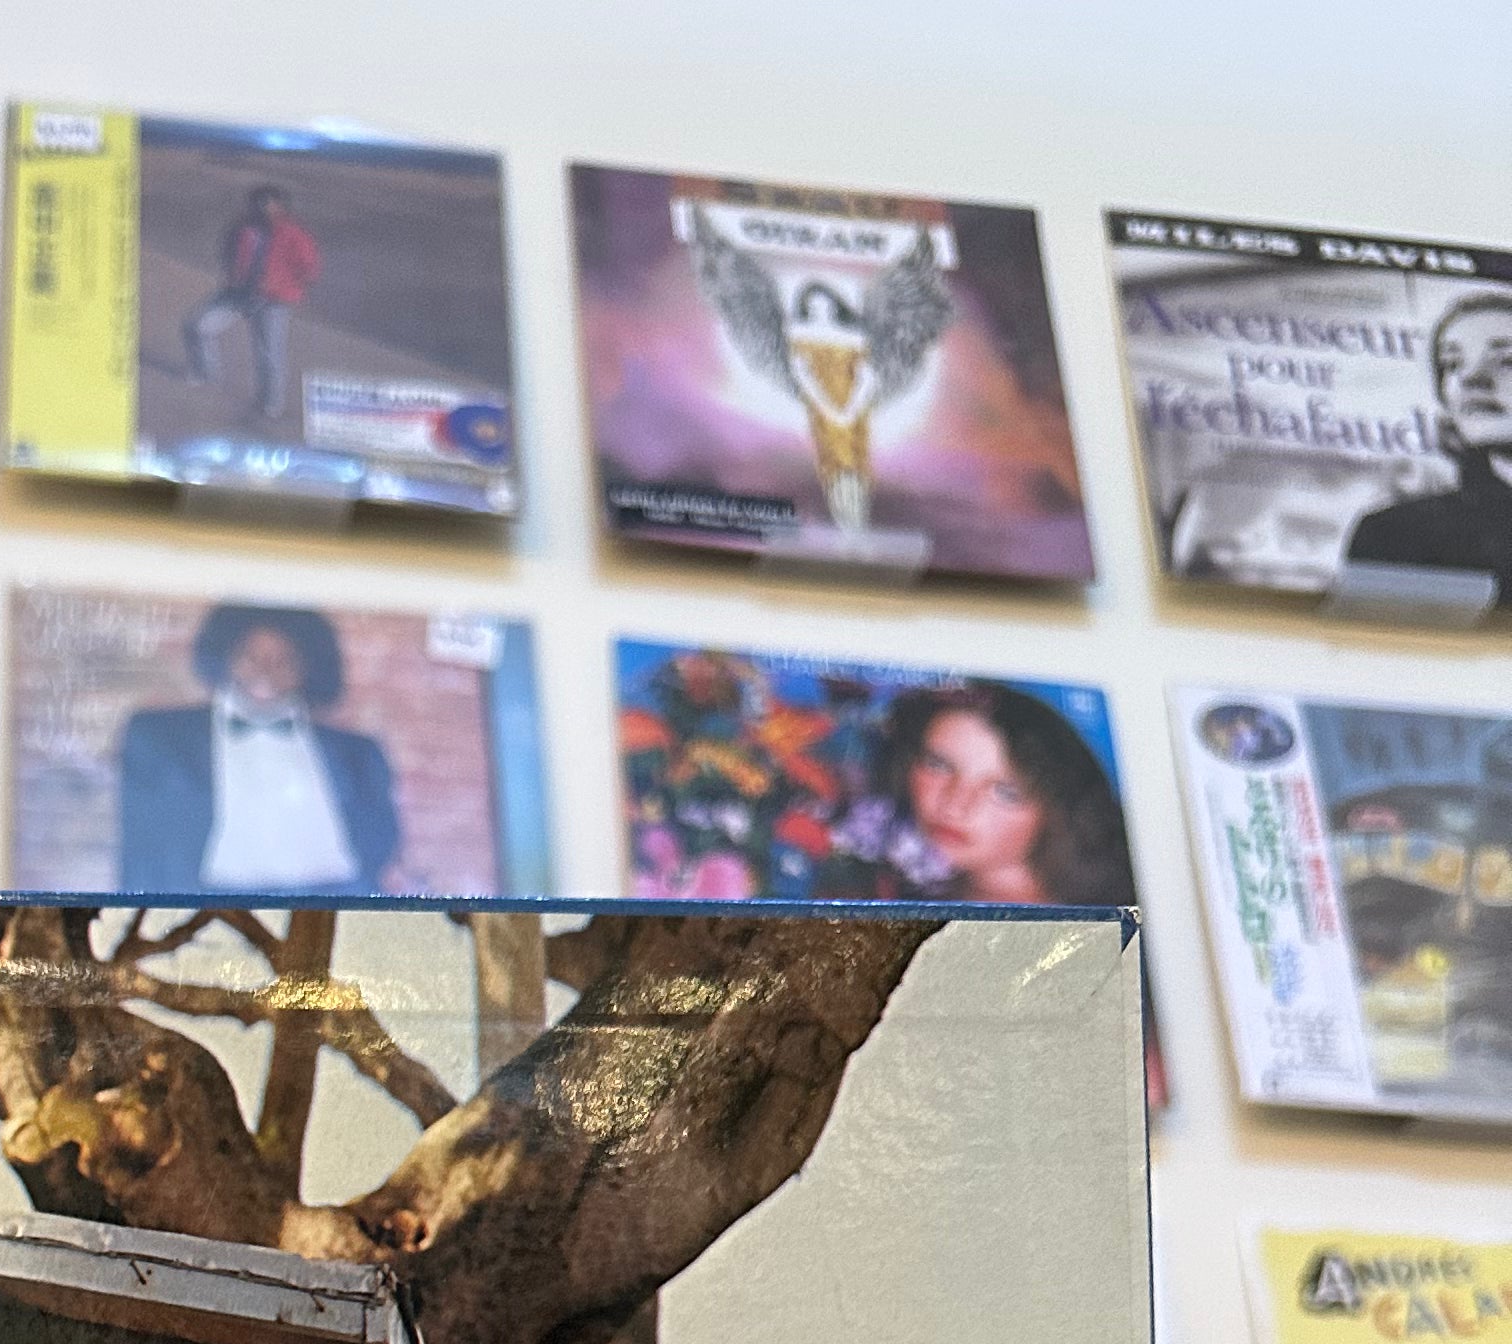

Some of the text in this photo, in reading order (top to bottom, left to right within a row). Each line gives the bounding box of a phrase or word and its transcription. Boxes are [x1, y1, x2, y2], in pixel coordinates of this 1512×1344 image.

[1124, 217, 1478, 275] MILES DAVIS
[1372, 1280, 1512, 1341] CALA
